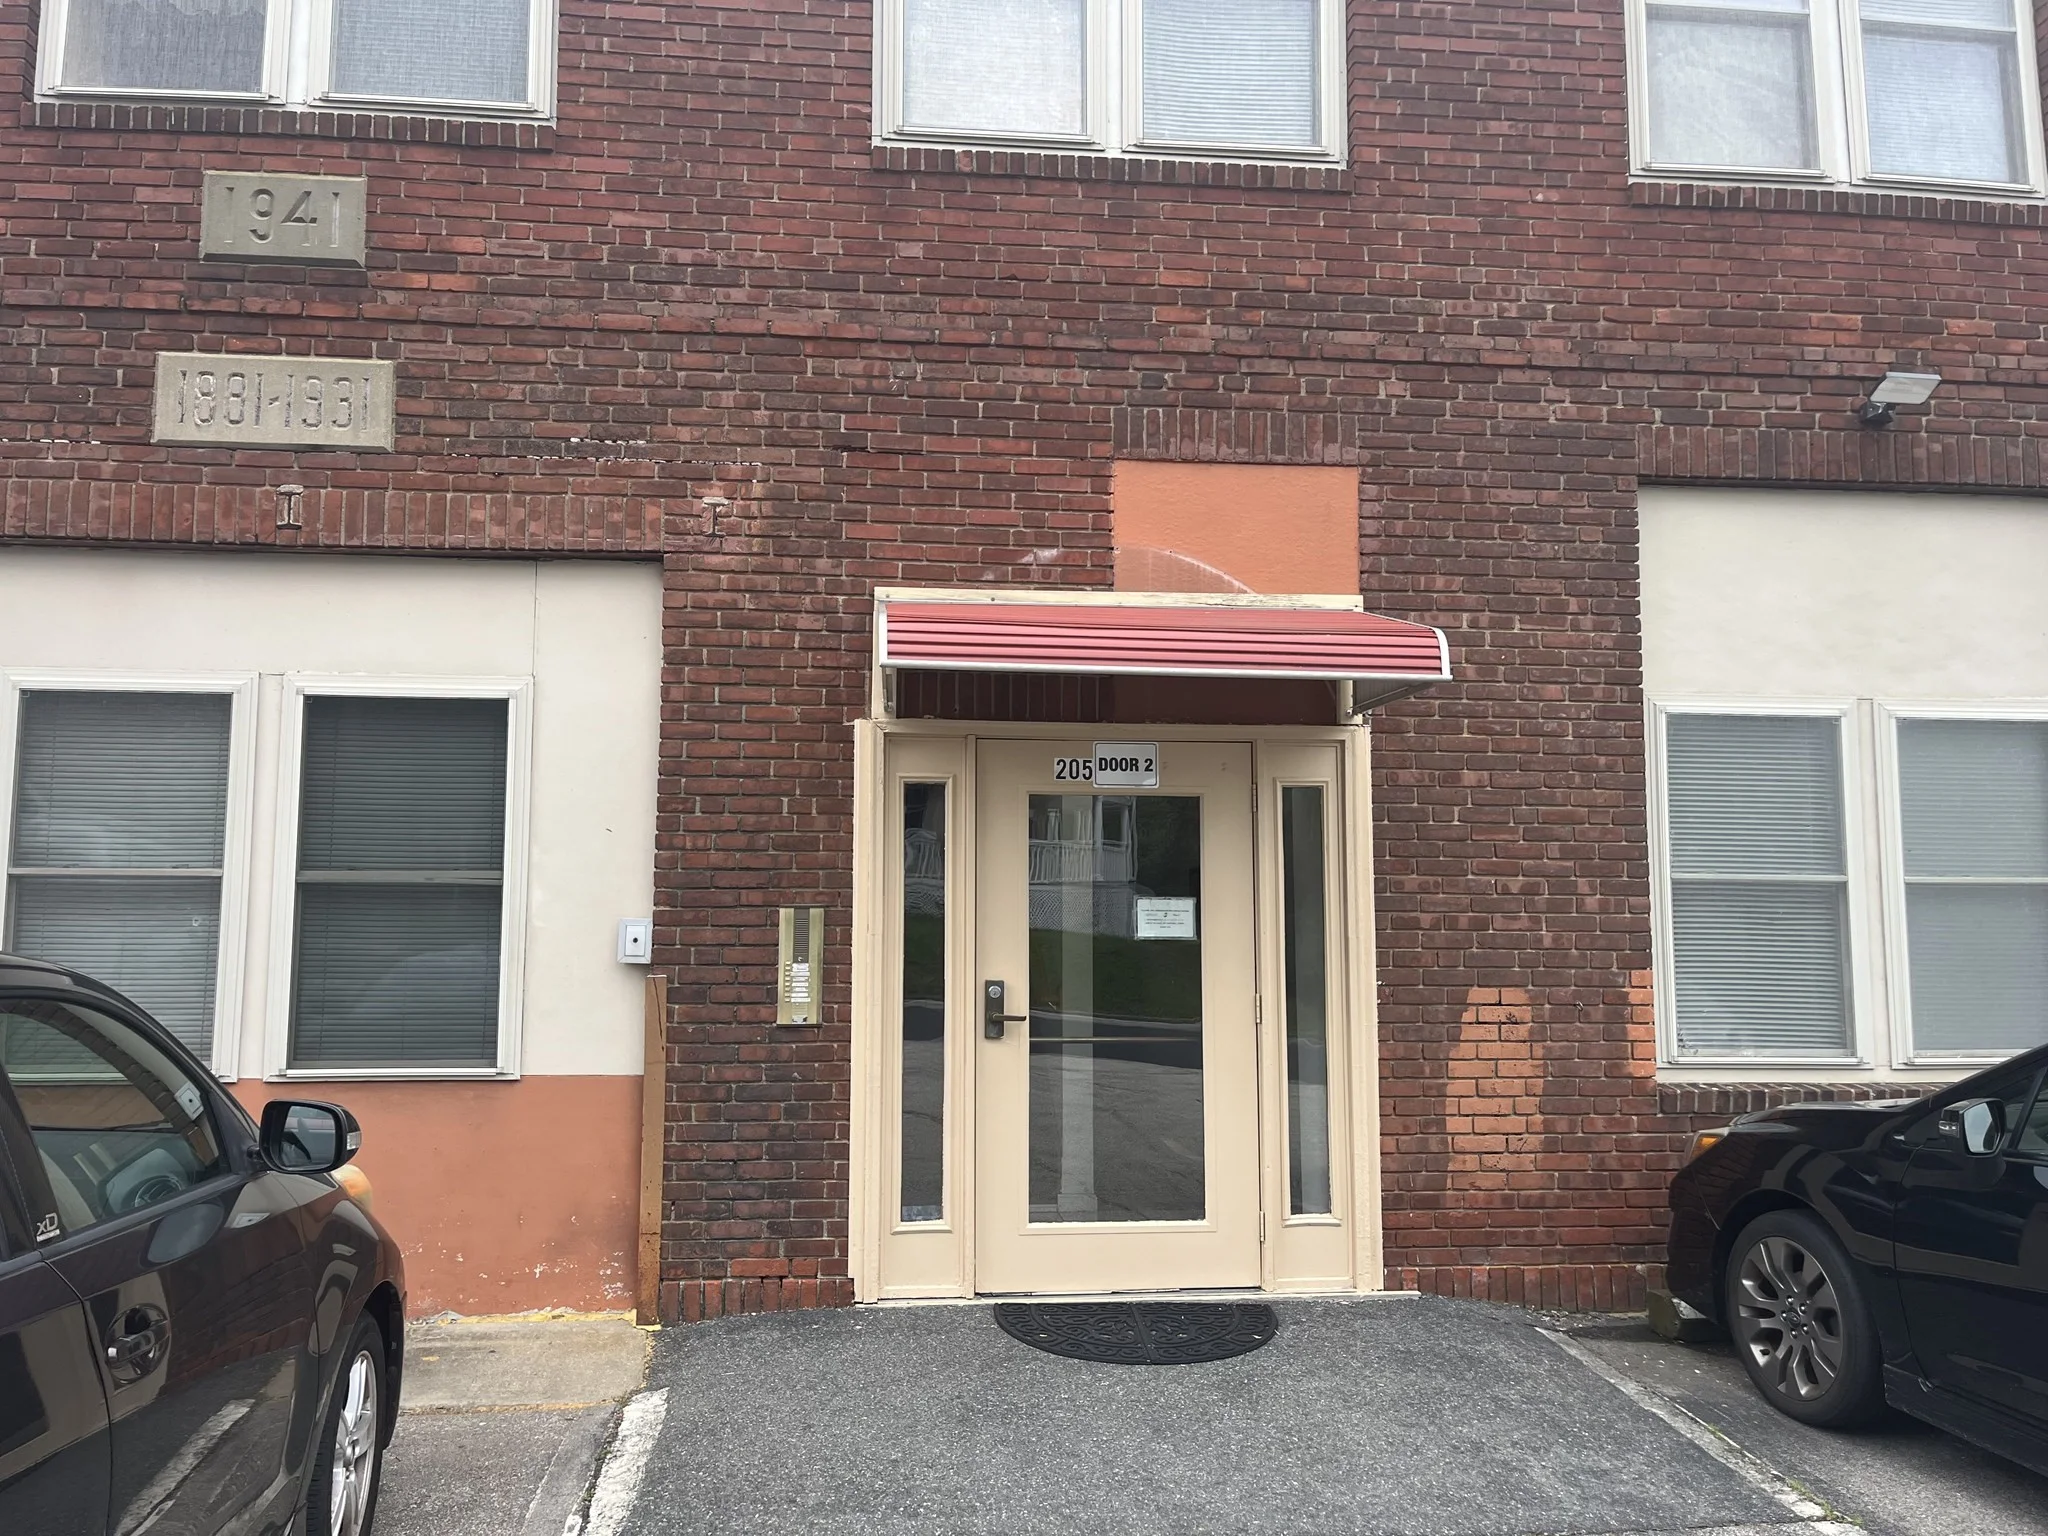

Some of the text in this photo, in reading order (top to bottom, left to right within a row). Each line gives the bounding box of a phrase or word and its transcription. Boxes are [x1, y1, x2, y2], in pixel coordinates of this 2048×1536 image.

[224, 187, 341, 247] 1941
[177, 369, 371, 433] 1881-1931
[1055, 758, 1093, 780] 205
[1098, 757, 1154, 772] DOOR 2
[36, 1212, 59, 1236] xD
